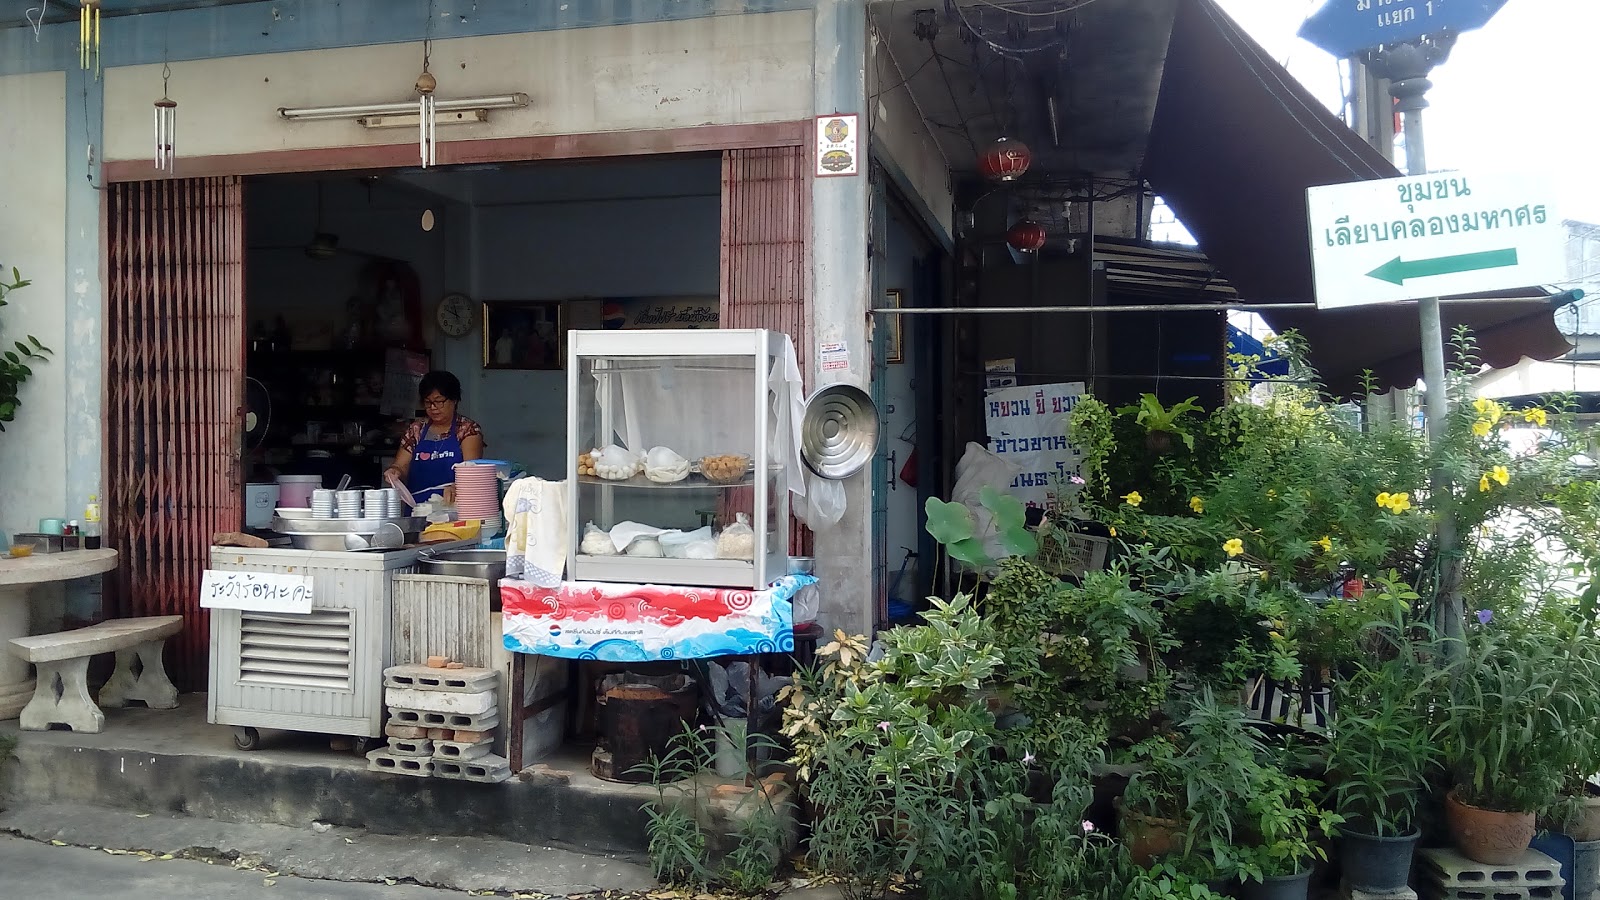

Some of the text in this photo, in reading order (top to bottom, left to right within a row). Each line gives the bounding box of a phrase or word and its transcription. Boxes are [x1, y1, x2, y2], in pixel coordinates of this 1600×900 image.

[1377, 6, 1415, 27] แยก
[1425, 1, 1433, 17] 1
[1397, 176, 1471, 214] ชุมชน
[1325, 203, 1547, 247] เลียบคลองมหาศร
[989, 399, 1030, 418] หยวน
[995, 431, 1081, 456] ข้าวขาหู
